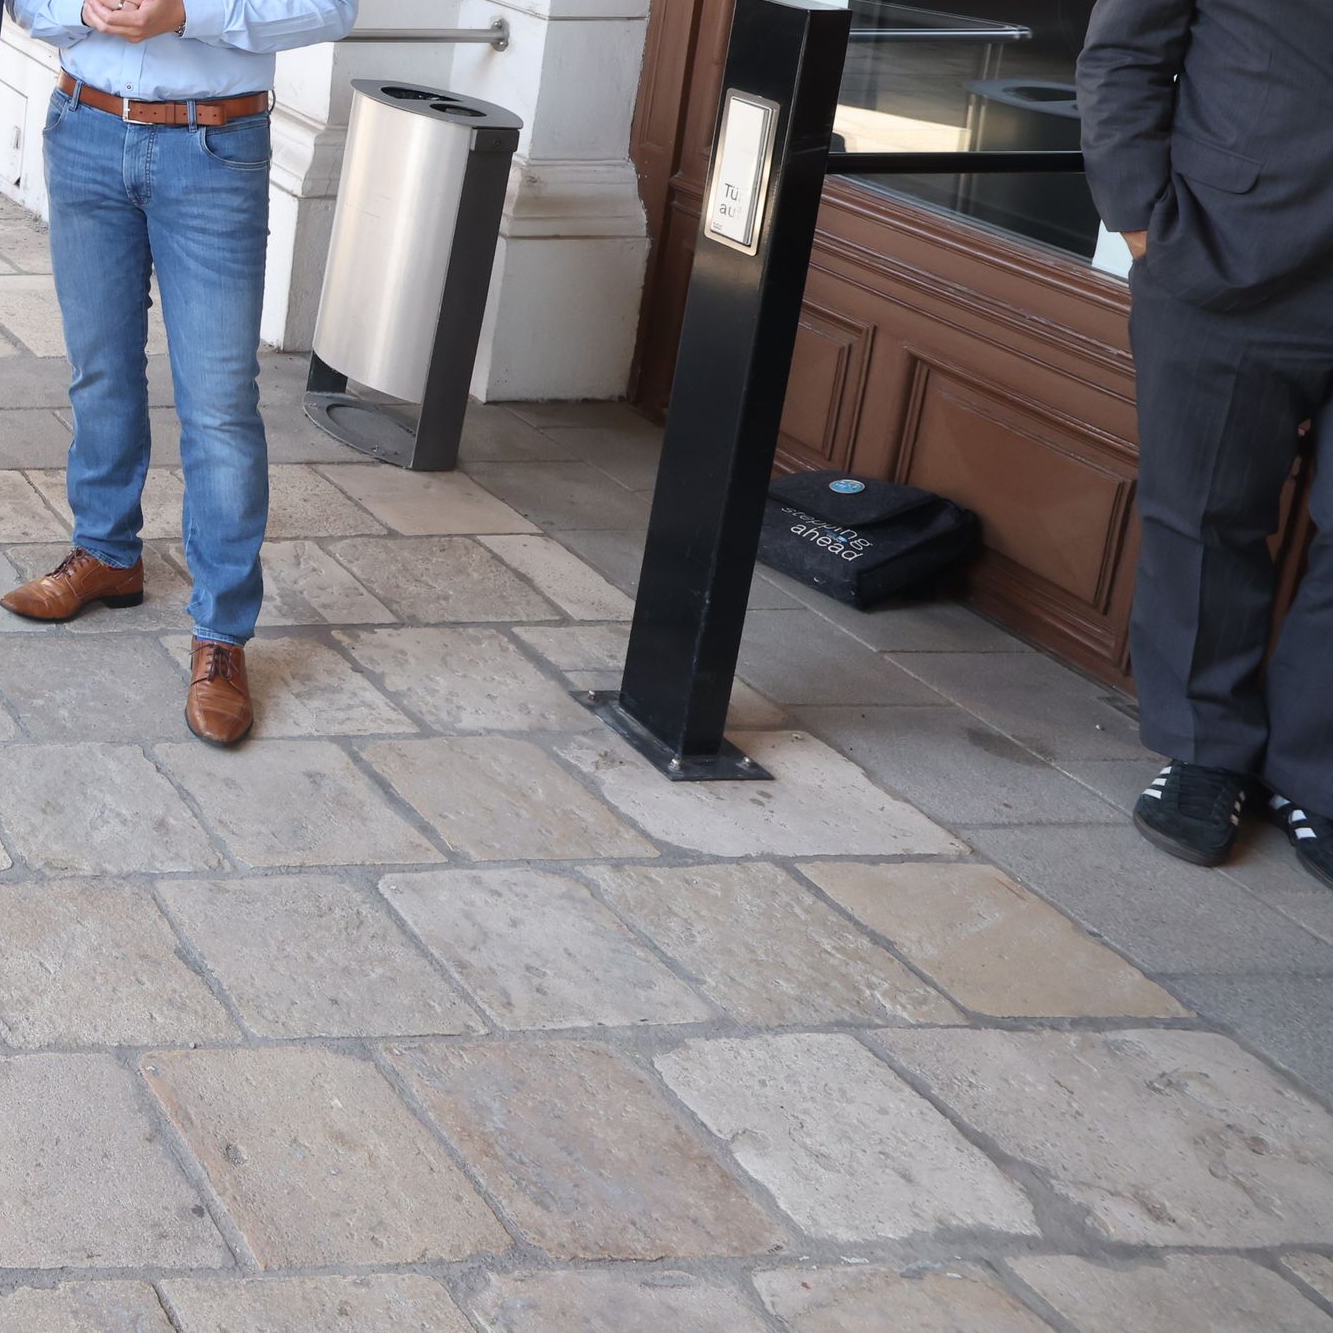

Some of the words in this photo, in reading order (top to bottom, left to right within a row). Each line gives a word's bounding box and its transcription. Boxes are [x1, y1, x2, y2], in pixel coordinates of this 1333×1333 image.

[725, 182, 741, 202] Tü
[781, 507, 874, 551] stepping
[790, 524, 864, 562] ahead
